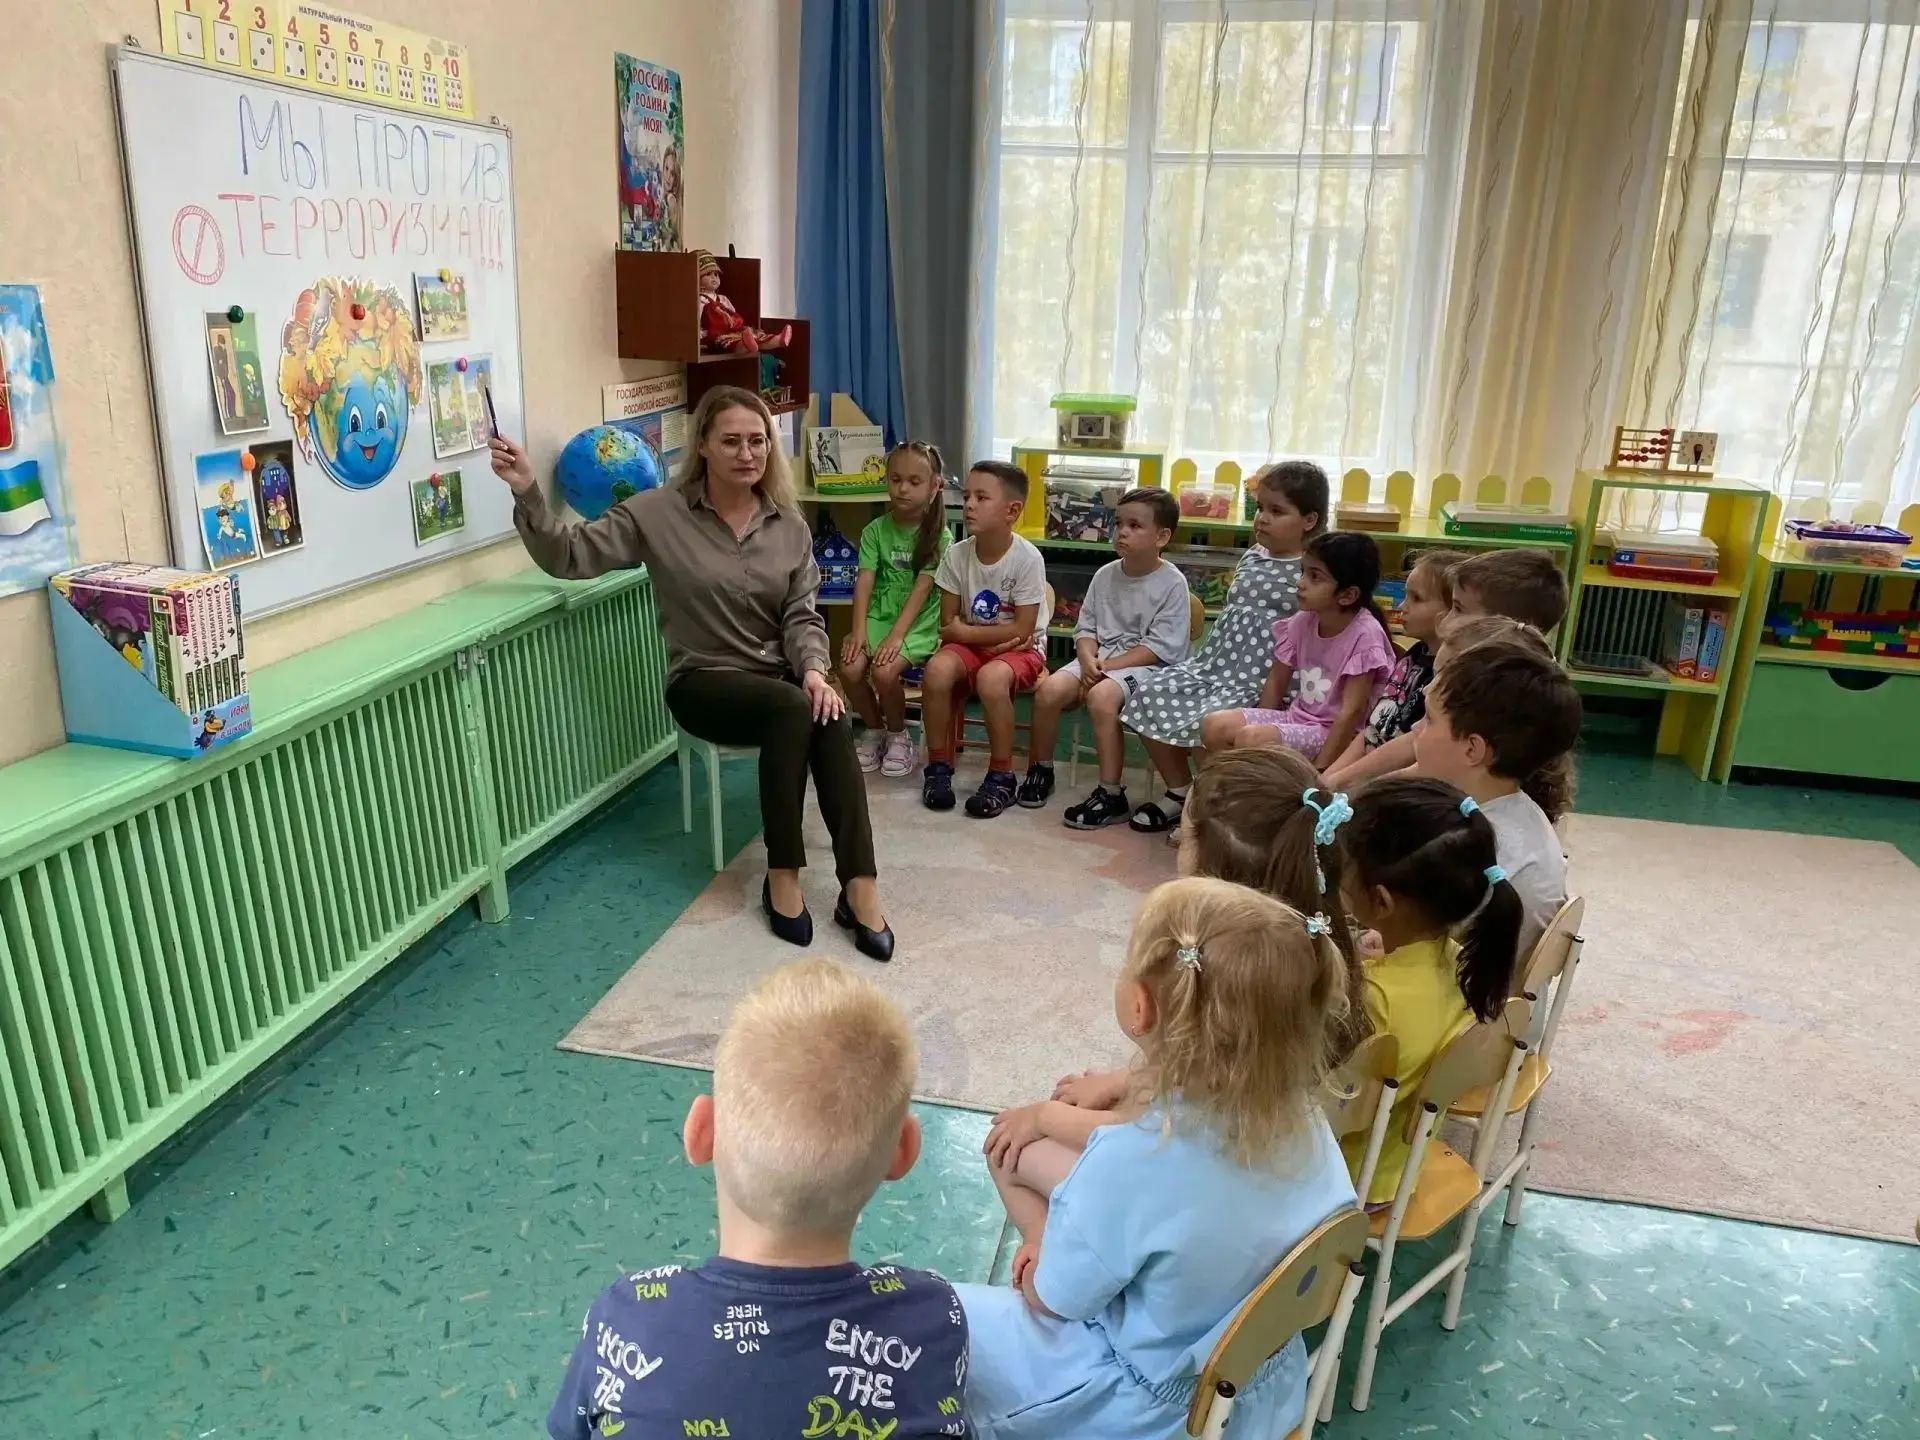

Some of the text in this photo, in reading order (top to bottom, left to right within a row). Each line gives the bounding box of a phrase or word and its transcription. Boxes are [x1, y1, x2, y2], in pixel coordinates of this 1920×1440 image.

[298, 5, 373, 33] НАТУРАЛЬНЫЙ РЯД ЧИСЕЛ
[218, 0, 231, 21] 2
[254, 6, 266, 29] 3
[287, 16, 298, 37] 4
[319, 23, 330, 45] 5
[348, 31, 359, 52] 6
[374, 38, 384, 58] 7
[400, 45, 409, 65] 8
[423, 52, 432, 71] 9
[442, 57, 459, 78] 10
[635, 91, 668, 114] РОДИНА
[643, 116, 662, 134] МОЯ!
[239, 94, 506, 204] МЫ ПРОТИВ
[623, 397, 655, 416] РОССИЙСКОЙ
[207, 596, 217, 649] МАТЕМАТИКА
[215, 594, 225, 641] МЫШЛЕНИЕ
[225, 591, 233, 625] ПАМЯТЬ
[188, 603, 200, 658] РАЗВИТИЕ РЕЧИ
[635, 1282, 668, 1302] FUN
[869, 1277, 906, 1295] FUN
[726, 1304, 762, 1319] HERE
[713, 1320, 771, 1340] RULES
[825, 1318, 922, 1372] ENJOY
[597, 1322, 664, 1380] NJOY
[736, 1339, 760, 1354] NO
[828, 1366, 896, 1409] THE
[683, 1417, 730, 1437] FUN
[801, 1395, 898, 1440] DAY
